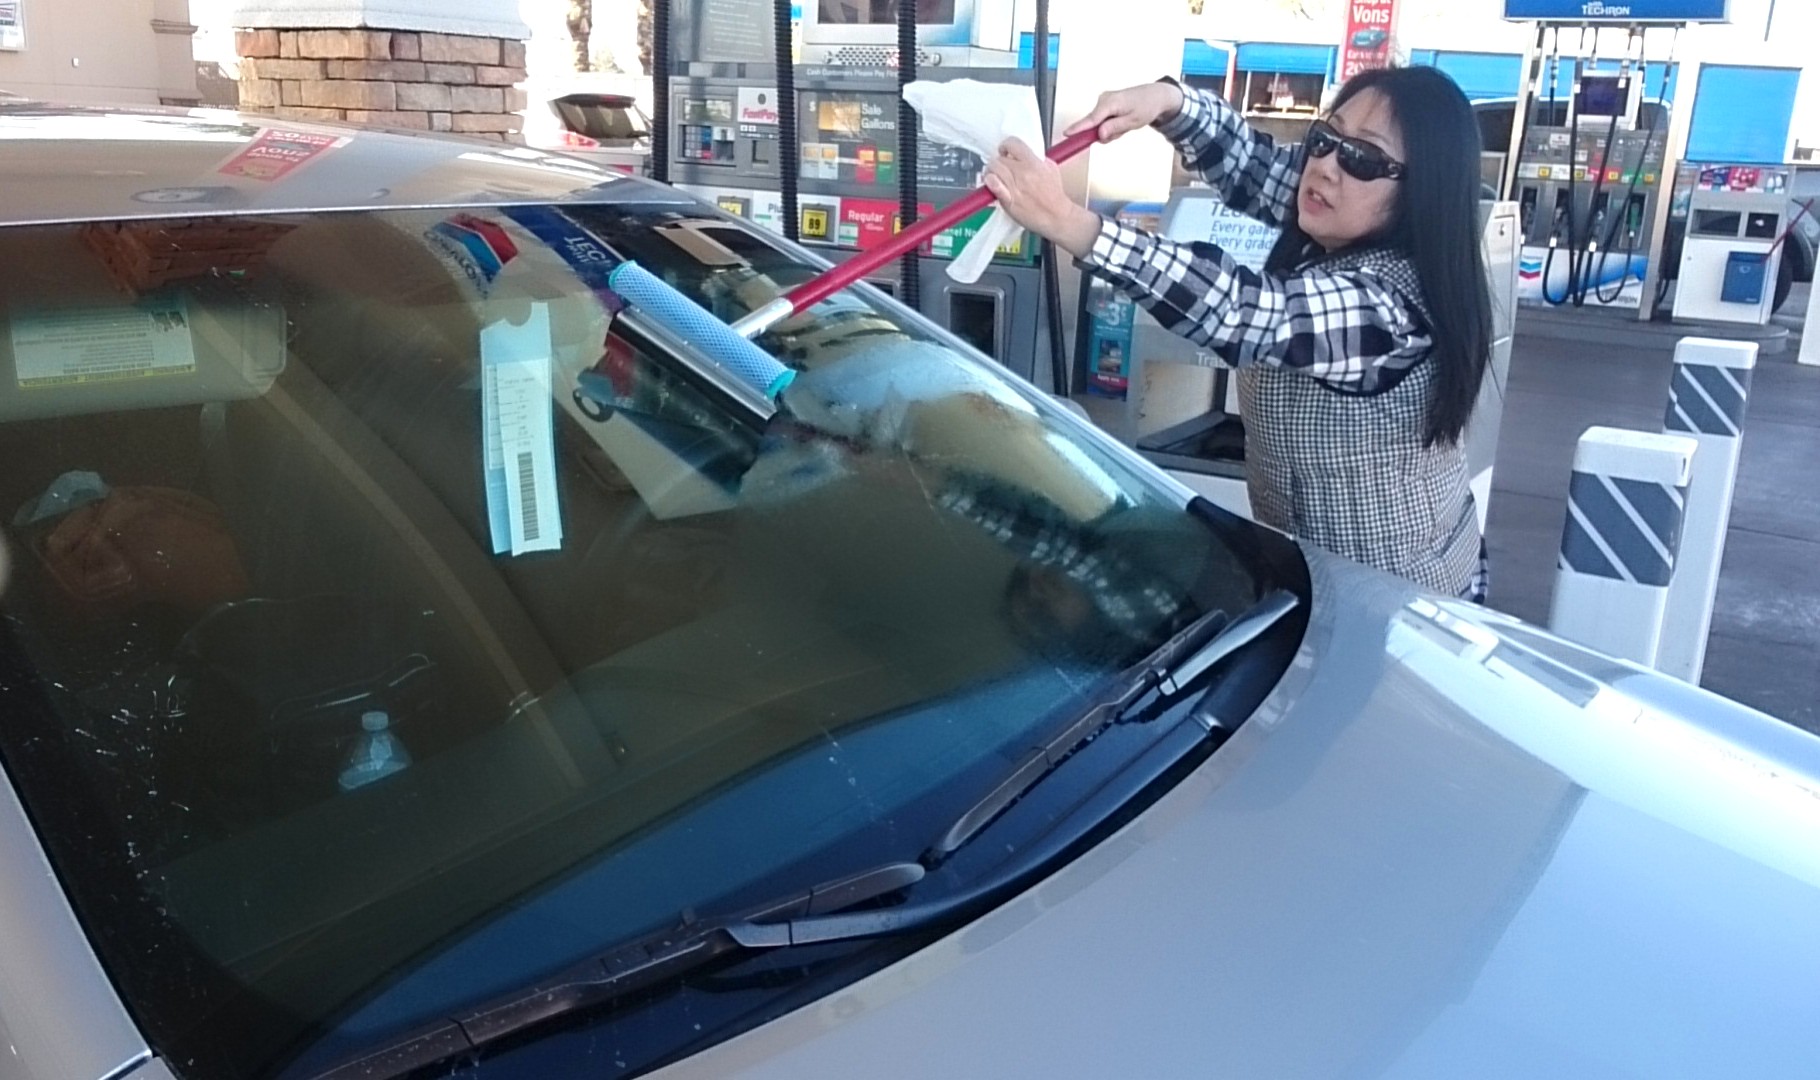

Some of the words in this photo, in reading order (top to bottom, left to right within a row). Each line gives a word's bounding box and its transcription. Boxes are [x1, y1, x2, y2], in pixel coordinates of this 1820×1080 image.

[1353, 5, 1390, 23] Vons
[1581, 4, 1630, 16] TECHRON
[806, 68, 821, 76] Cash
[822, 68, 853, 77] Customers
[854, 69, 874, 77] Please
[875, 70, 885, 78] Pay
[743, 107, 777, 122] FastPay
[861, 103, 882, 115] Sale
[861, 118, 895, 129] Gallons
[768, 203, 784, 213] Plu
[848, 209, 885, 223] Regular
[808, 218, 821, 230] 89
[1212, 220, 1245, 235] Every
[1209, 233, 1242, 250] Every
[1244, 238, 1273, 251] grad
